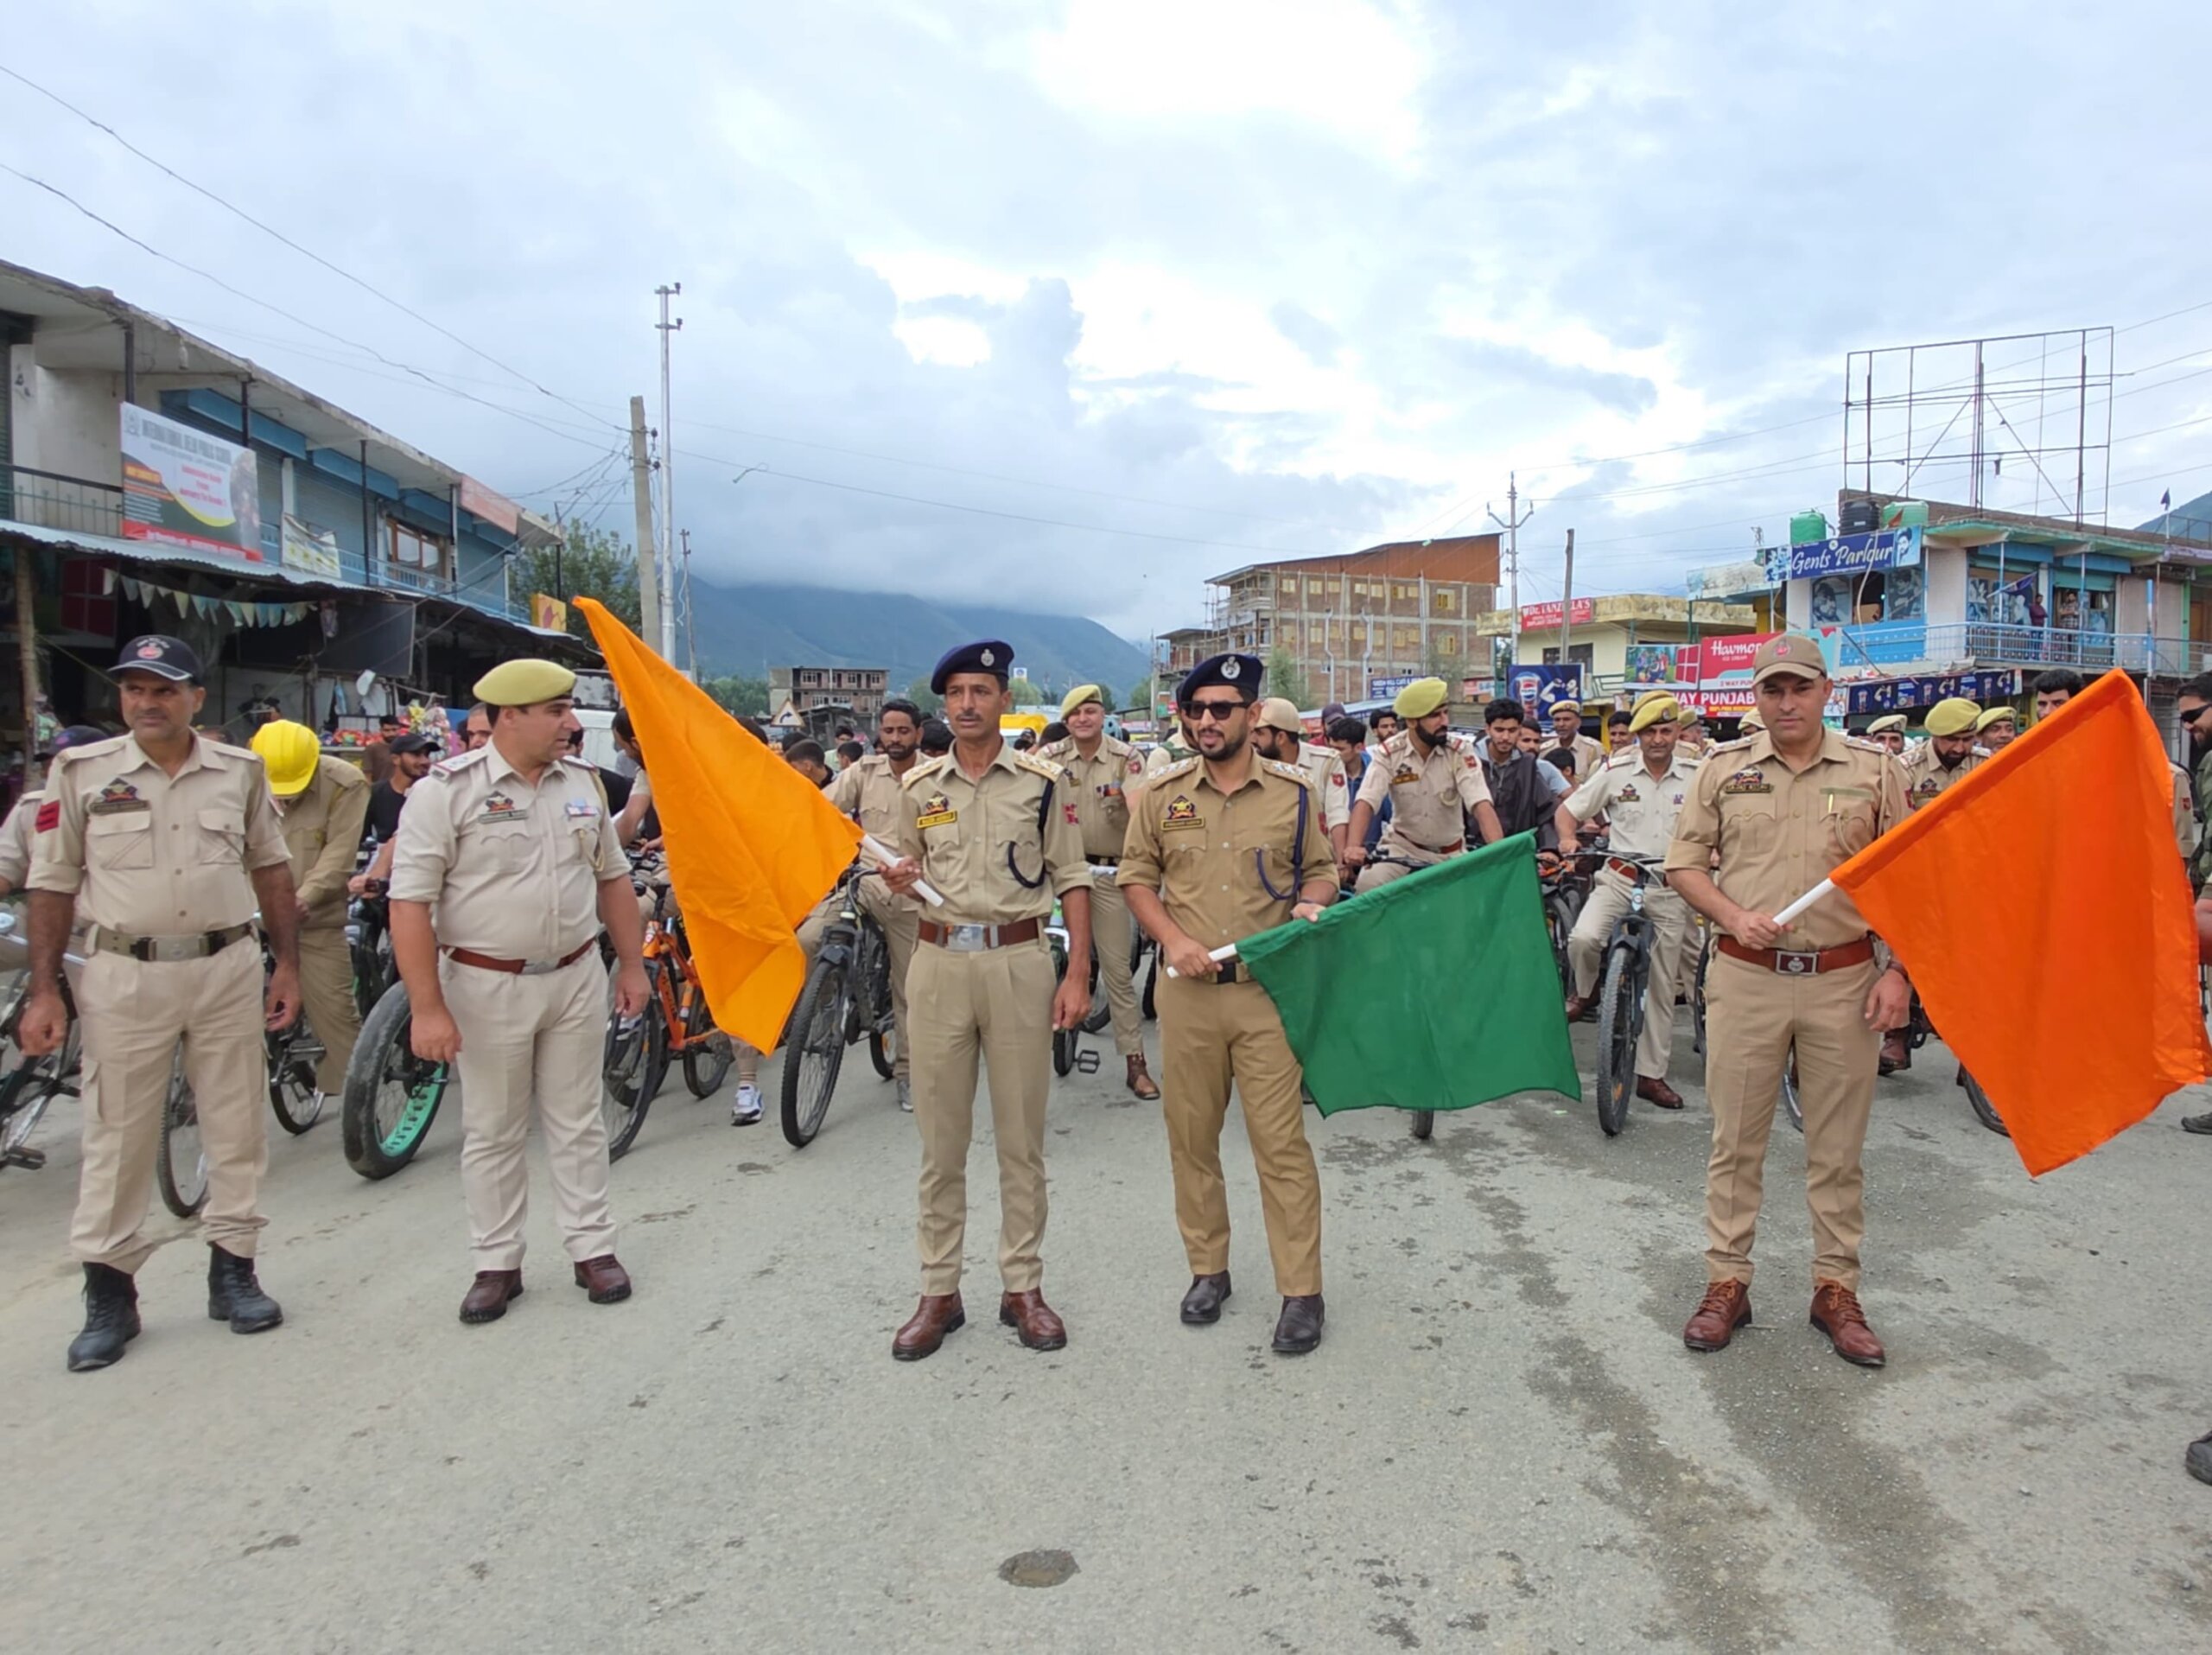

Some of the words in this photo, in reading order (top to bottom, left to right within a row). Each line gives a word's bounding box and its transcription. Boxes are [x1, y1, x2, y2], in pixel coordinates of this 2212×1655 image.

[1792, 549, 1831, 574] Gents
[1835, 538, 1893, 567] Parlour
[1700, 691, 1756, 704] PUNJAB
